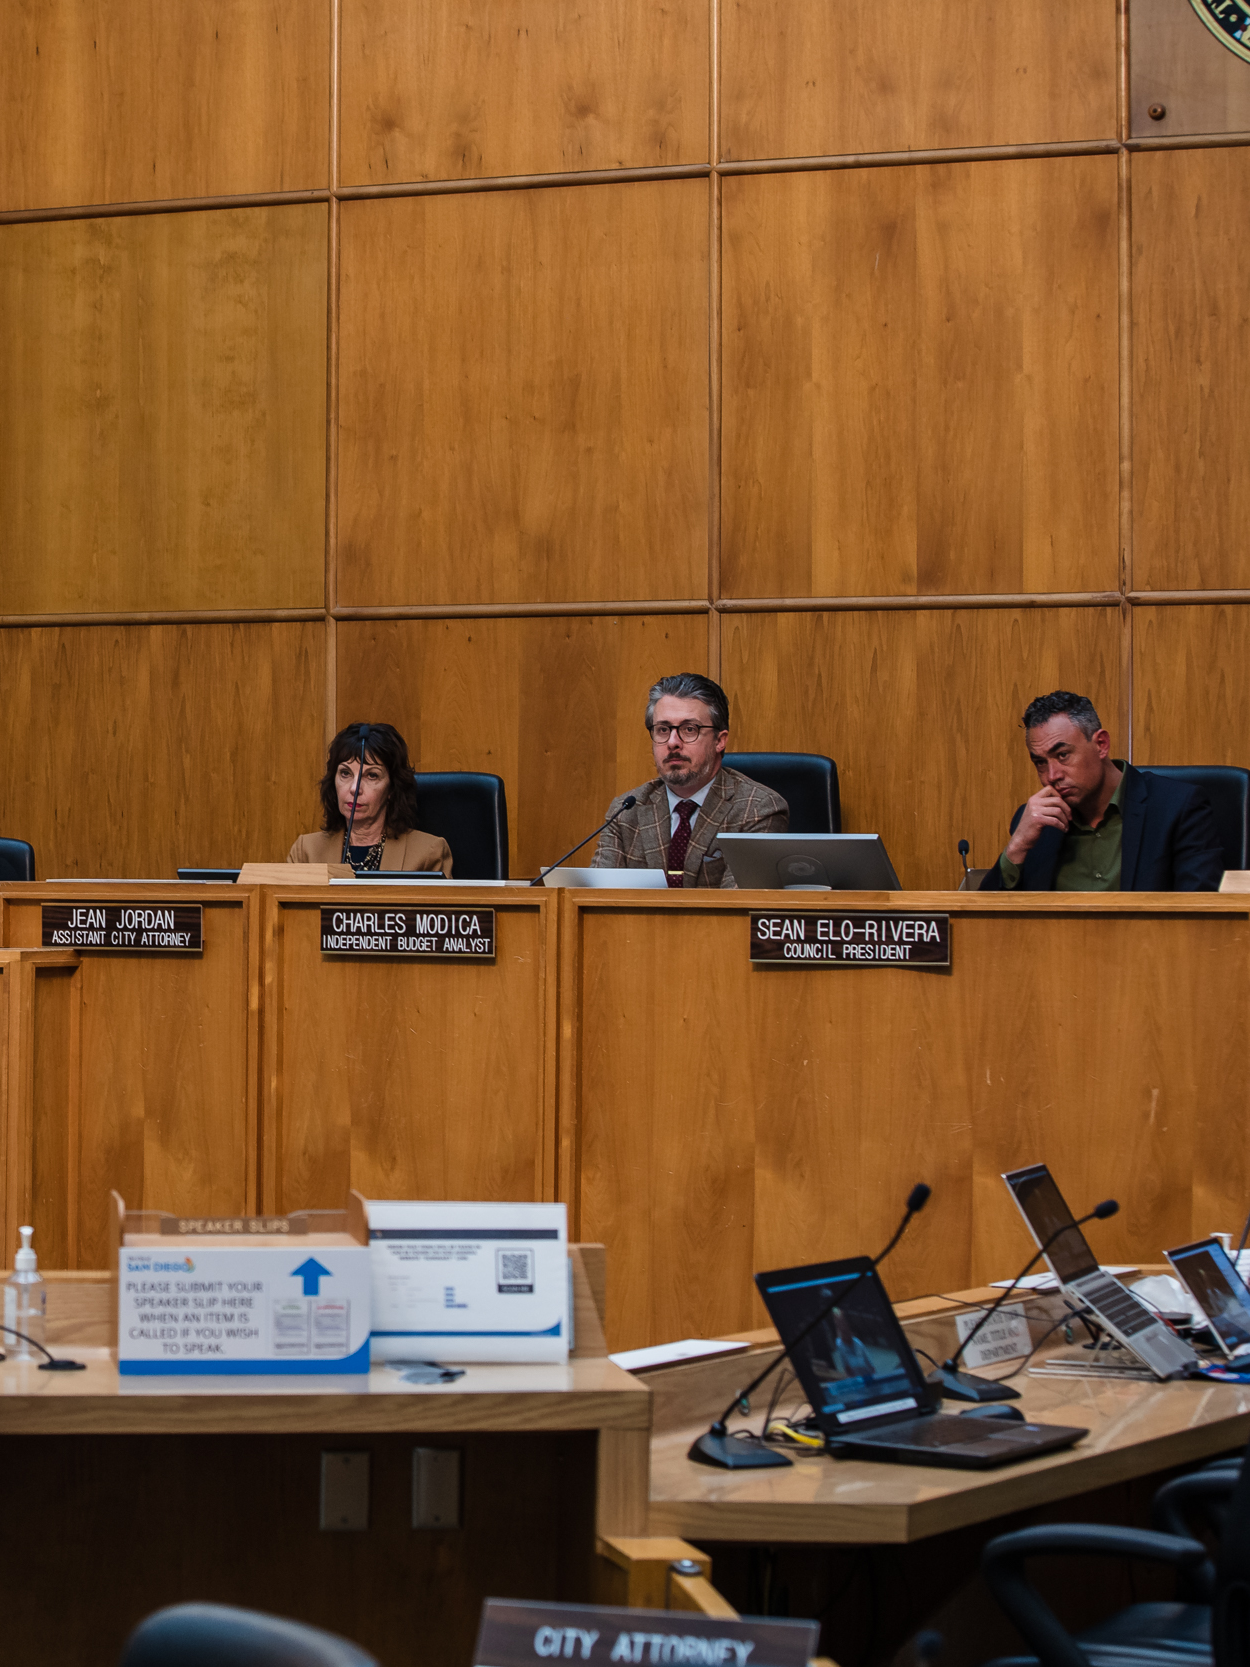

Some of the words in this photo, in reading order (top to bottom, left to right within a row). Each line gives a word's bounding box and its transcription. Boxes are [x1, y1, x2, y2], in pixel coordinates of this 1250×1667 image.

[67, 908, 106, 929] JEAN
[116, 909, 175, 930] JORDAN
[332, 912, 406, 934] CHARLES
[416, 914, 481, 935] MODICA
[757, 918, 805, 940] SEAN
[817, 919, 940, 942] ELO-RIVERA
[52, 930, 106, 945] ASSISTANT
[111, 931, 136, 945] CITY
[141, 932, 191, 946] ATTORNEY
[323, 935, 393, 950] INDEPENDENT
[398, 936, 438, 951] BUDGET
[443, 938, 491, 953] ANALYST
[783, 943, 836, 958] COUNCIL
[843, 945, 912, 960] PRESIDENT
[178, 1219, 243, 1233] SPEAKER
[249, 1219, 290, 1233] SLIPS
[126, 1262, 150, 1273] SAN
[153, 1262, 188, 1273] DIEGO
[126, 1281, 172, 1294] PLEASE
[176, 1281, 223, 1294] SUBMIT
[226, 1281, 263, 1294] YOUR
[133, 1297, 188, 1309] SPEAKER
[192, 1297, 218, 1309] SLIP
[221, 1297, 254, 1309] HERE
[138, 1312, 179, 1324] WHEN
[182, 1312, 200, 1324] AN
[204, 1312, 235, 1324] ITEM
[239, 1312, 250, 1324] IS
[129, 1327, 177, 1340] CALLED
[180, 1327, 191, 1339] IF
[193, 1327, 221, 1339] YOU
[224, 1327, 260, 1339] WISH
[162, 1342, 180, 1354] TO
[533, 1626, 600, 1660] CITY
[610, 1631, 756, 1667] ATTORNEY
